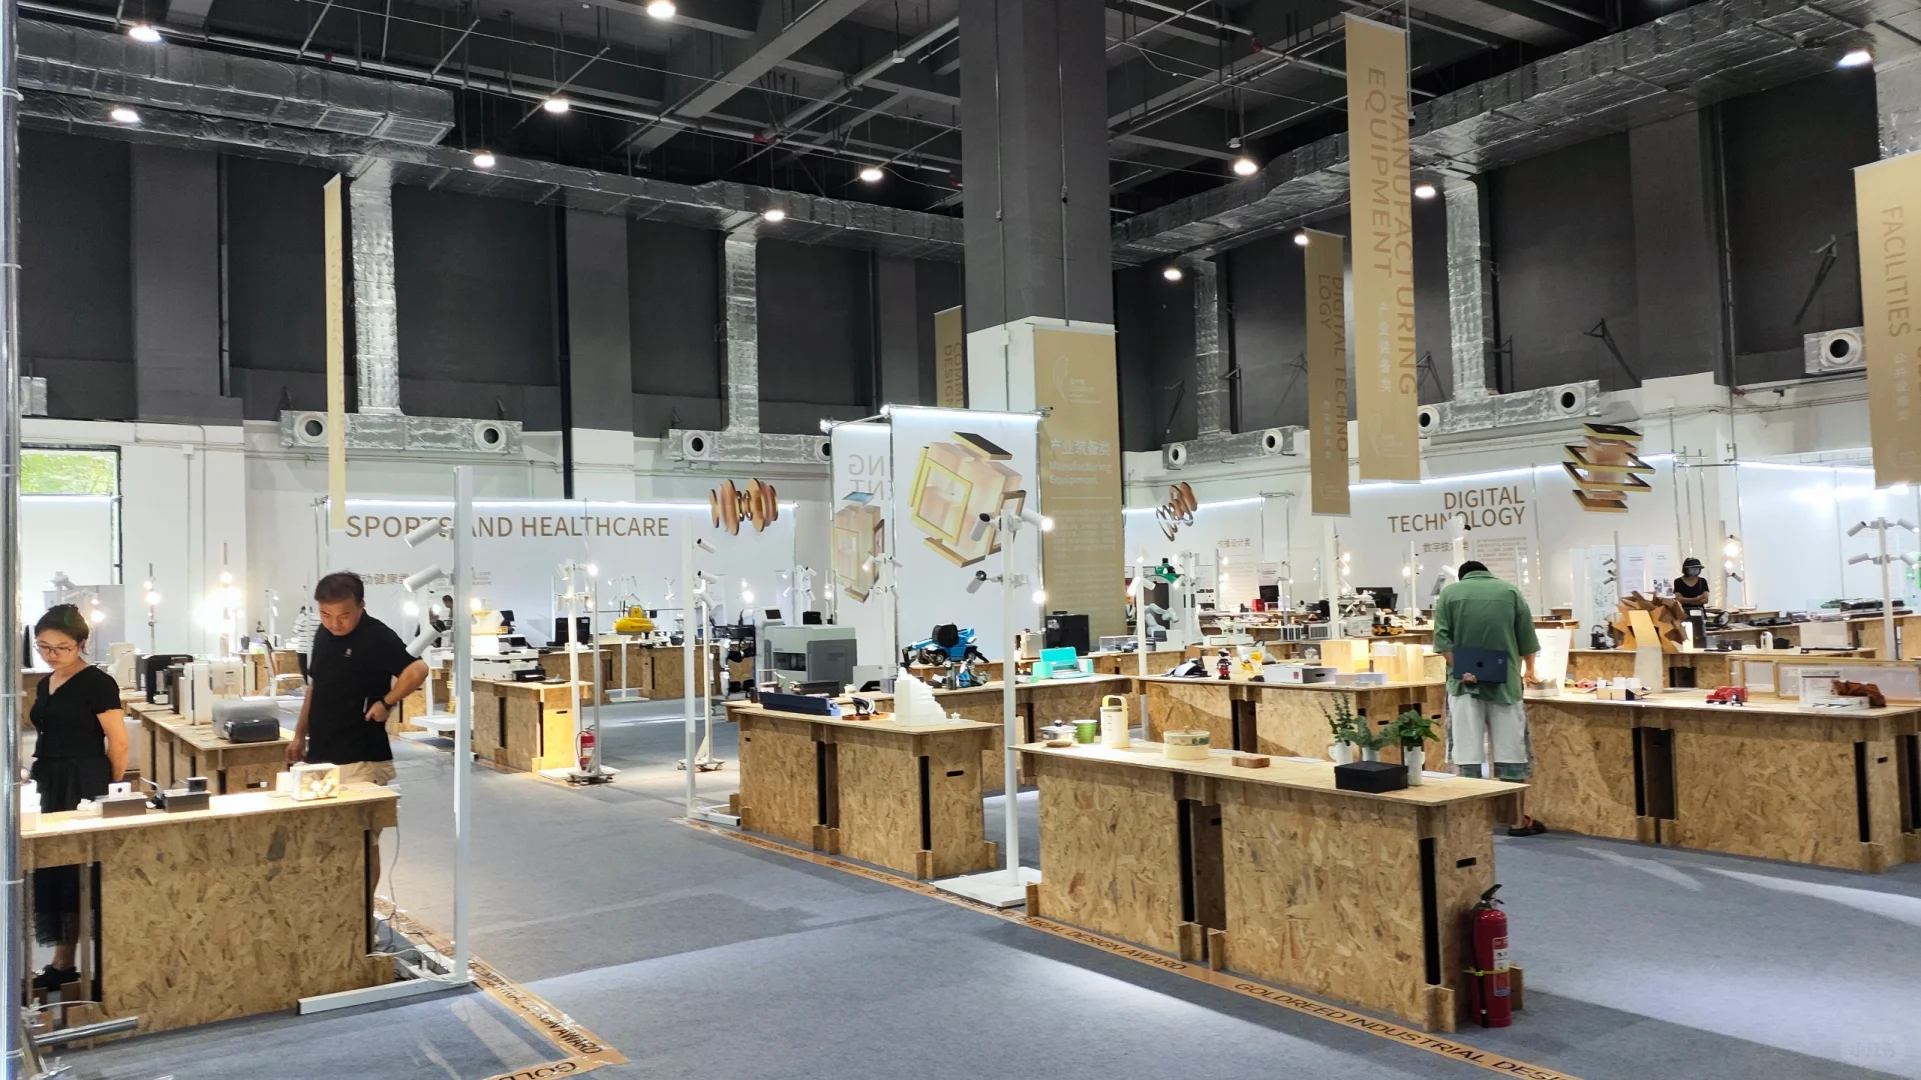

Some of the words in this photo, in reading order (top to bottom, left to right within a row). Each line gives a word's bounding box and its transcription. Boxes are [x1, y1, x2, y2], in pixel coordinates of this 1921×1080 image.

[1365, 67, 1392, 278] EQUIPMENT
[1390, 94, 1417, 396] MANUFACTURING
[1881, 205, 1911, 338] FACILITIES
[1318, 273, 1332, 329] LOGY
[1048, 439, 1112, 456] 产业装备类
[1048, 461, 1113, 475] Manufacturing
[1049, 474, 1099, 486] Equipment
[1443, 485, 1525, 510] DIGITAL
[471, 516, 513, 537] ND
[521, 516, 670, 537] HEALTHCARE
[1065, 931, 1125, 951] DESIGN
[1124, 949, 1188, 970] AWARD
[1234, 983, 1347, 1019] GOLDREED
[1346, 1017, 1486, 1063] INDUSTRIAL
